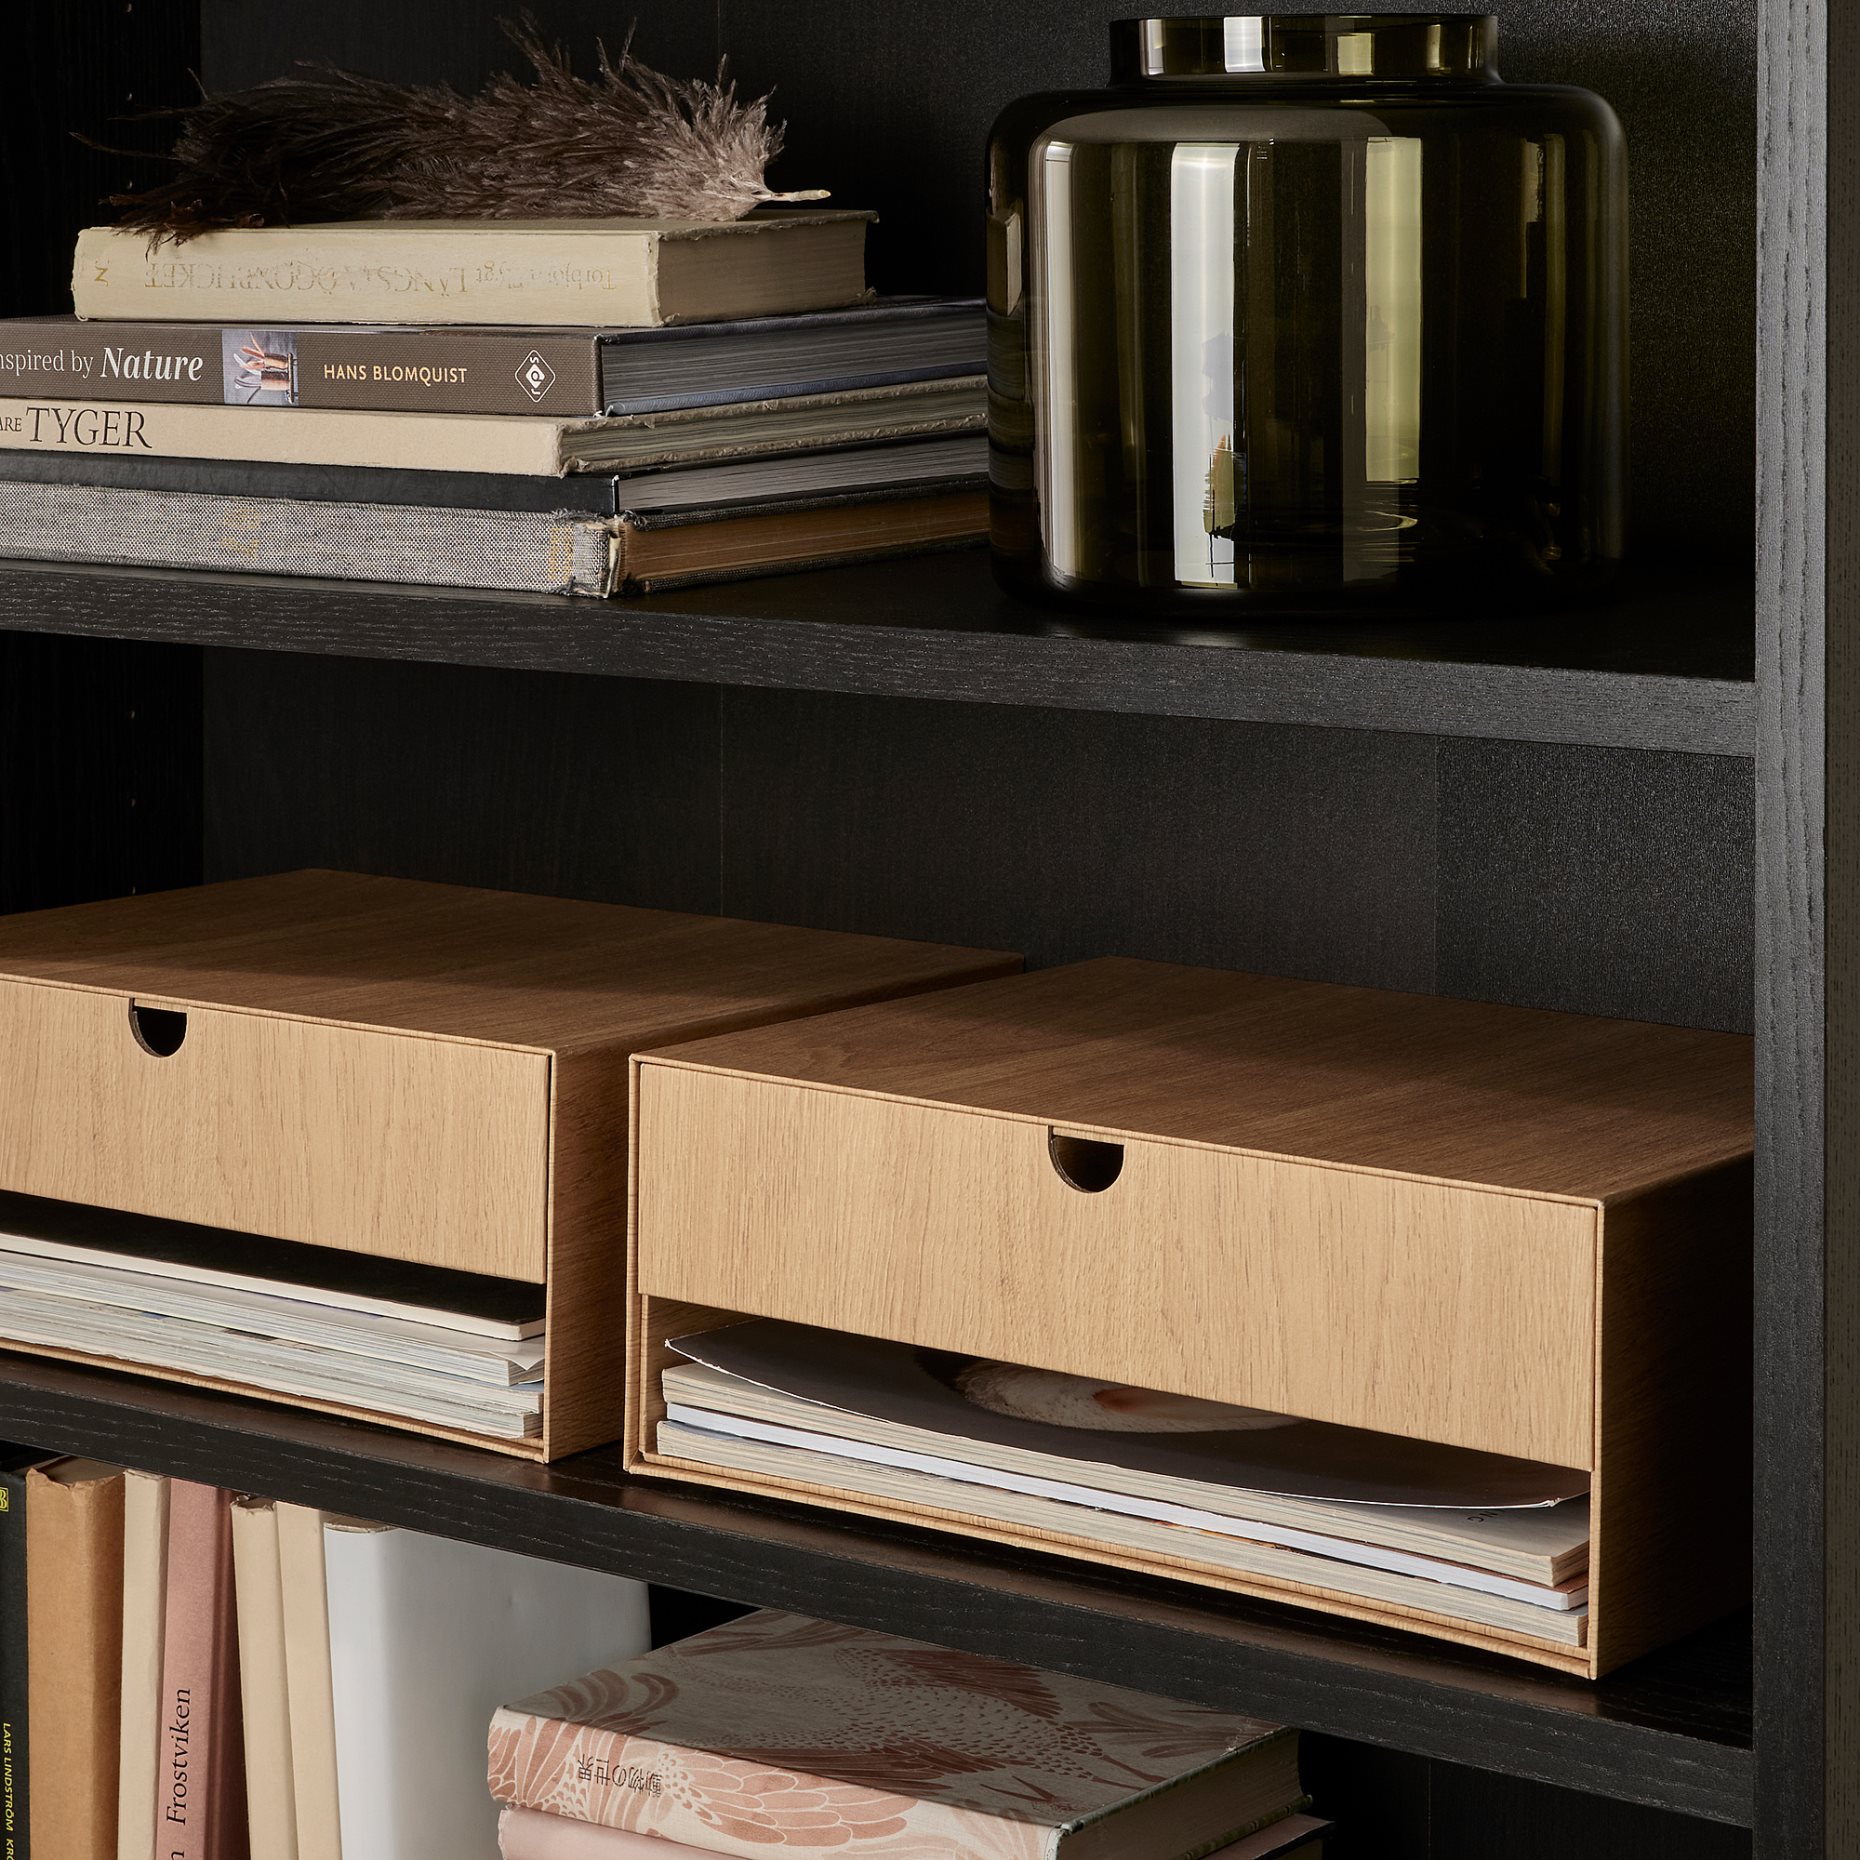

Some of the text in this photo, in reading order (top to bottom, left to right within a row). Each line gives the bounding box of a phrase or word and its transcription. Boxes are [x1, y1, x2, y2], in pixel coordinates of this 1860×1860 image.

[71, 350, 94, 379] by
[100, 347, 204, 381] Nature
[323, 364, 468, 387] HANS BLOMQUIST
[26, 406, 153, 449] TYGER
[3, 1722, 12, 1754] LARS
[166, 1688, 191, 1826] Frostviken
[4, 1757, 15, 1832] LINDSTRÖM
[577, 1753, 664, 1798] 動物の世界
